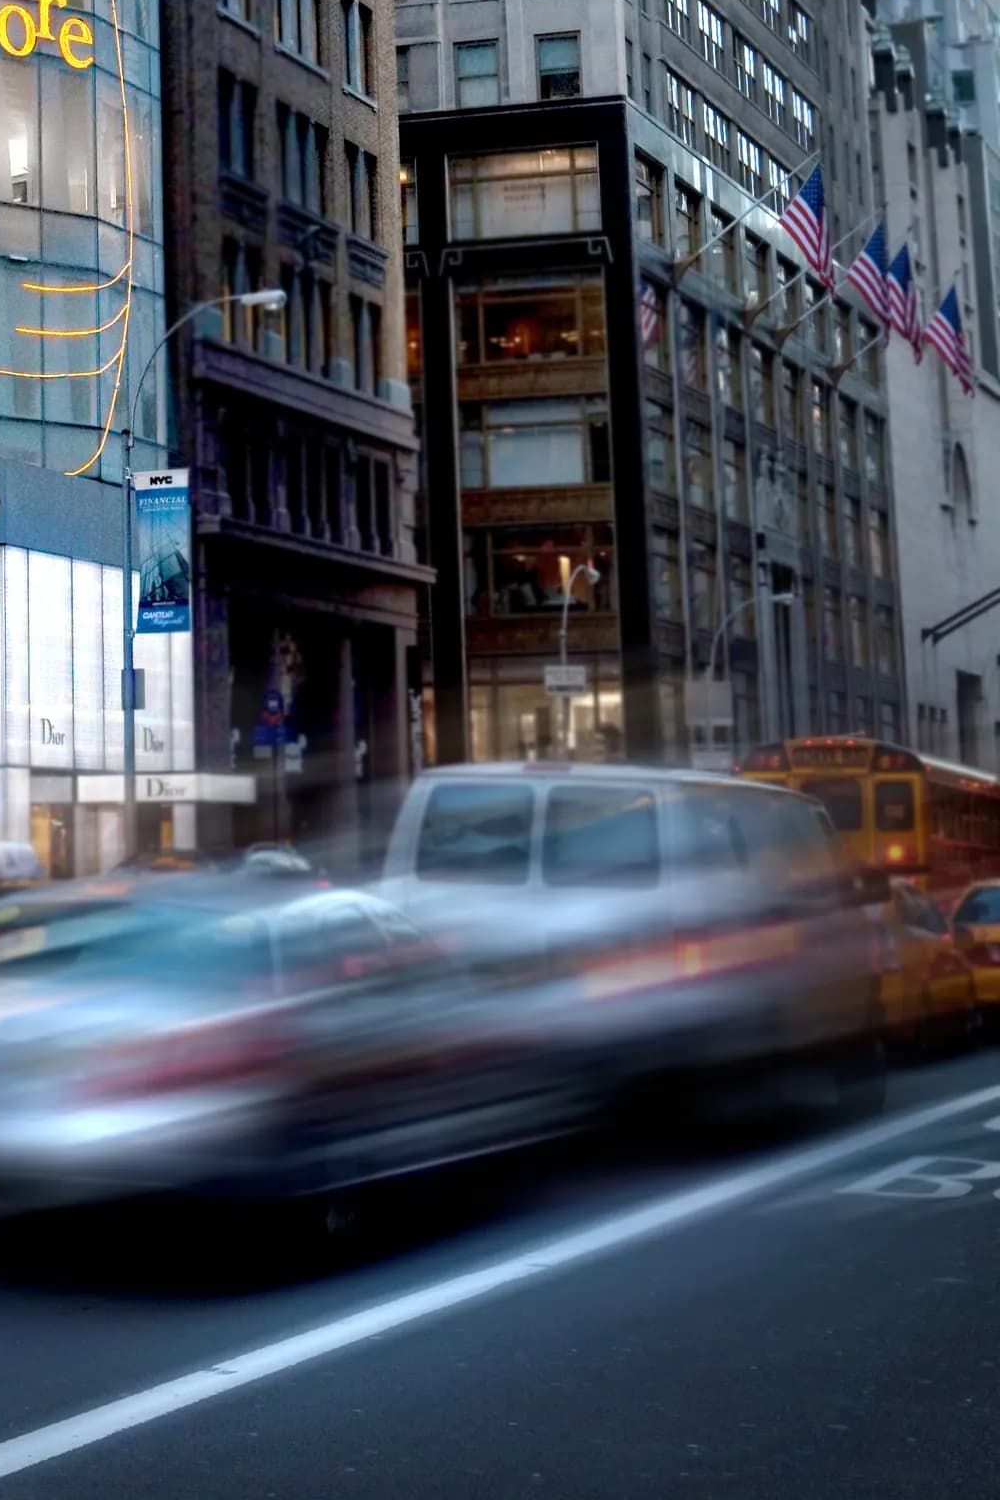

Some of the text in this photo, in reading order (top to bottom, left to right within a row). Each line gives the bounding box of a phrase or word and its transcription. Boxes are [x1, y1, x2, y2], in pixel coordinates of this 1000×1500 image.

[149, 475, 173, 486] NYC
[41, 718, 65, 745] Dior
[143, 727, 164, 752] Dior
[146, 778, 187, 798] Dior
